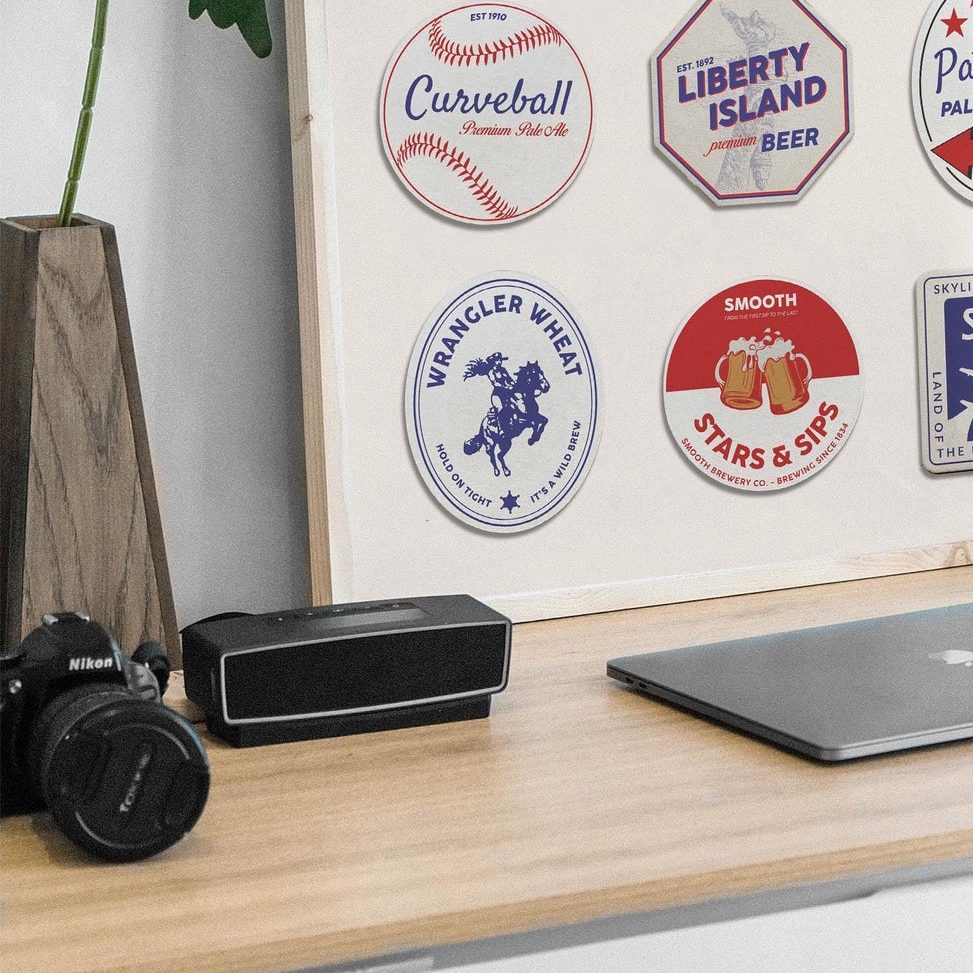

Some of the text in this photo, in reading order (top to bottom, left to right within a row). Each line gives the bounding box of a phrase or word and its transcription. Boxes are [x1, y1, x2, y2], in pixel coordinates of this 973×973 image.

[470, 13, 506, 21] EST 1910
[677, 57, 714, 73] EST. 1892
[678, 42, 810, 104] LIBERTY
[405, 74, 572, 121] Curveball
[709, 76, 827, 131] ISLAND
[459, 120, 569, 137] Premium Pale Ale
[703, 127, 819, 157] premium BEER
[724, 293, 797, 312] SMOOTH
[427, 294, 582, 388] WRANGLER WHEAT
[932, 372, 944, 443] LAND OF
[681, 438, 710, 470] SMOOTH
[711, 467, 751, 486] BREWERY
[777, 462, 815, 485] BREWING
[815, 442, 837, 464] SINCE
[835, 423, 848, 441] 1834
[694, 401, 839, 470] STARS & SIPS
[937, 447, 964, 458] THE
[436, 444, 492, 507] HOLD ON TIGHT
[530, 421, 581, 503] IT'S A WILD BREW
[69, 657, 112, 670] Nikon
